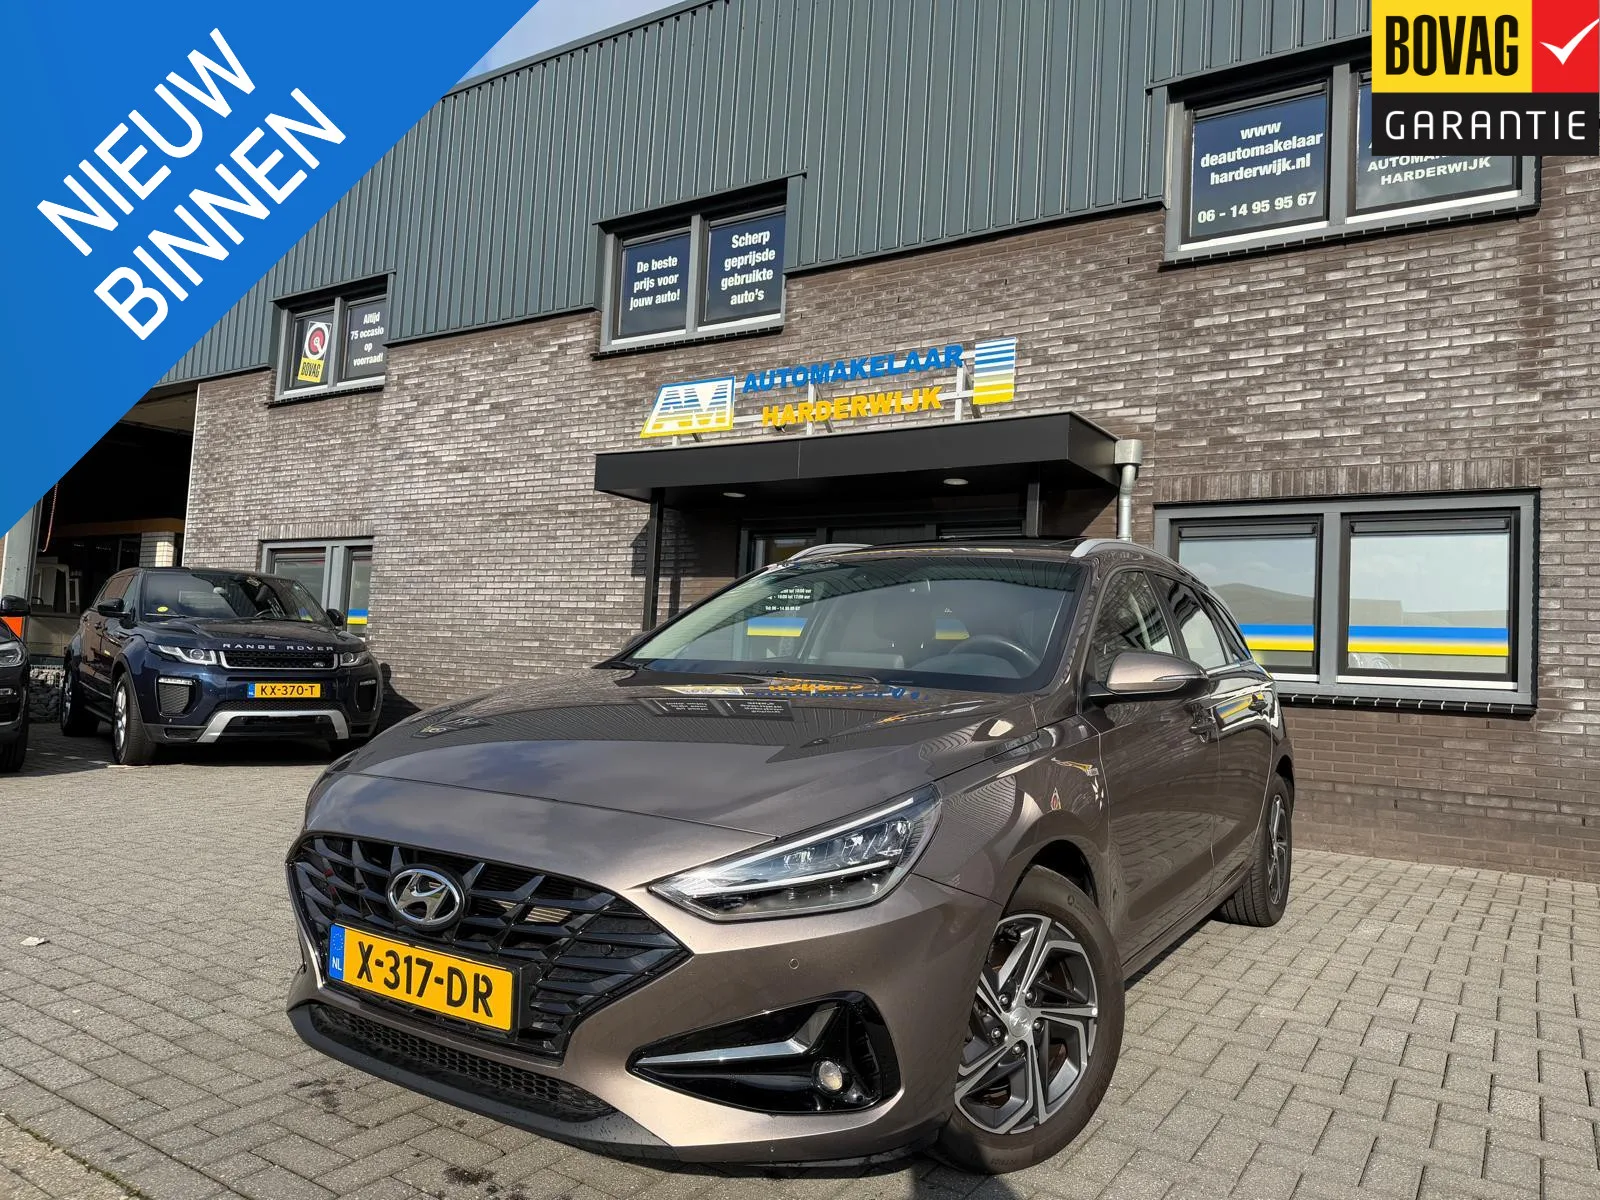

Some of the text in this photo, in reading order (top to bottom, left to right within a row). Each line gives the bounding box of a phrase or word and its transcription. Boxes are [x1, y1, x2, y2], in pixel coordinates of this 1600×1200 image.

[1240, 122, 1282, 140] www
[1200, 132, 1324, 168] deautomakelaar
[1210, 152, 1311, 185] harderwijk.nl
[1380, 156, 1492, 186] HARDERWIJK
[1198, 210, 1216, 223] 06
[1230, 204, 1248, 218] 14
[1252, 200, 1270, 214] 95
[1274, 196, 1293, 210] 95
[1297, 191, 1317, 206] 67
[732, 230, 770, 248] Scherp
[636, 256, 678, 274] De beste
[724, 248, 776, 272] geprijsde
[633, 274, 679, 293] prijs voor
[720, 268, 774, 290] gebruikte
[629, 289, 681, 311] jouw auto!
[730, 289, 764, 305] auto's
[363, 312, 380, 325] Altijd
[350, 330, 358, 340] 75
[364, 343, 373, 352] op
[353, 352, 384, 367] voorraad!
[742, 343, 964, 394] AUTOMAKELAAR
[300, 362, 321, 378] BOVAG
[761, 386, 942, 428] HARDERWIJK
[260, 685, 315, 695] KX-370-T
[331, 956, 342, 972] NL
[356, 941, 493, 1018] X-317-DR
